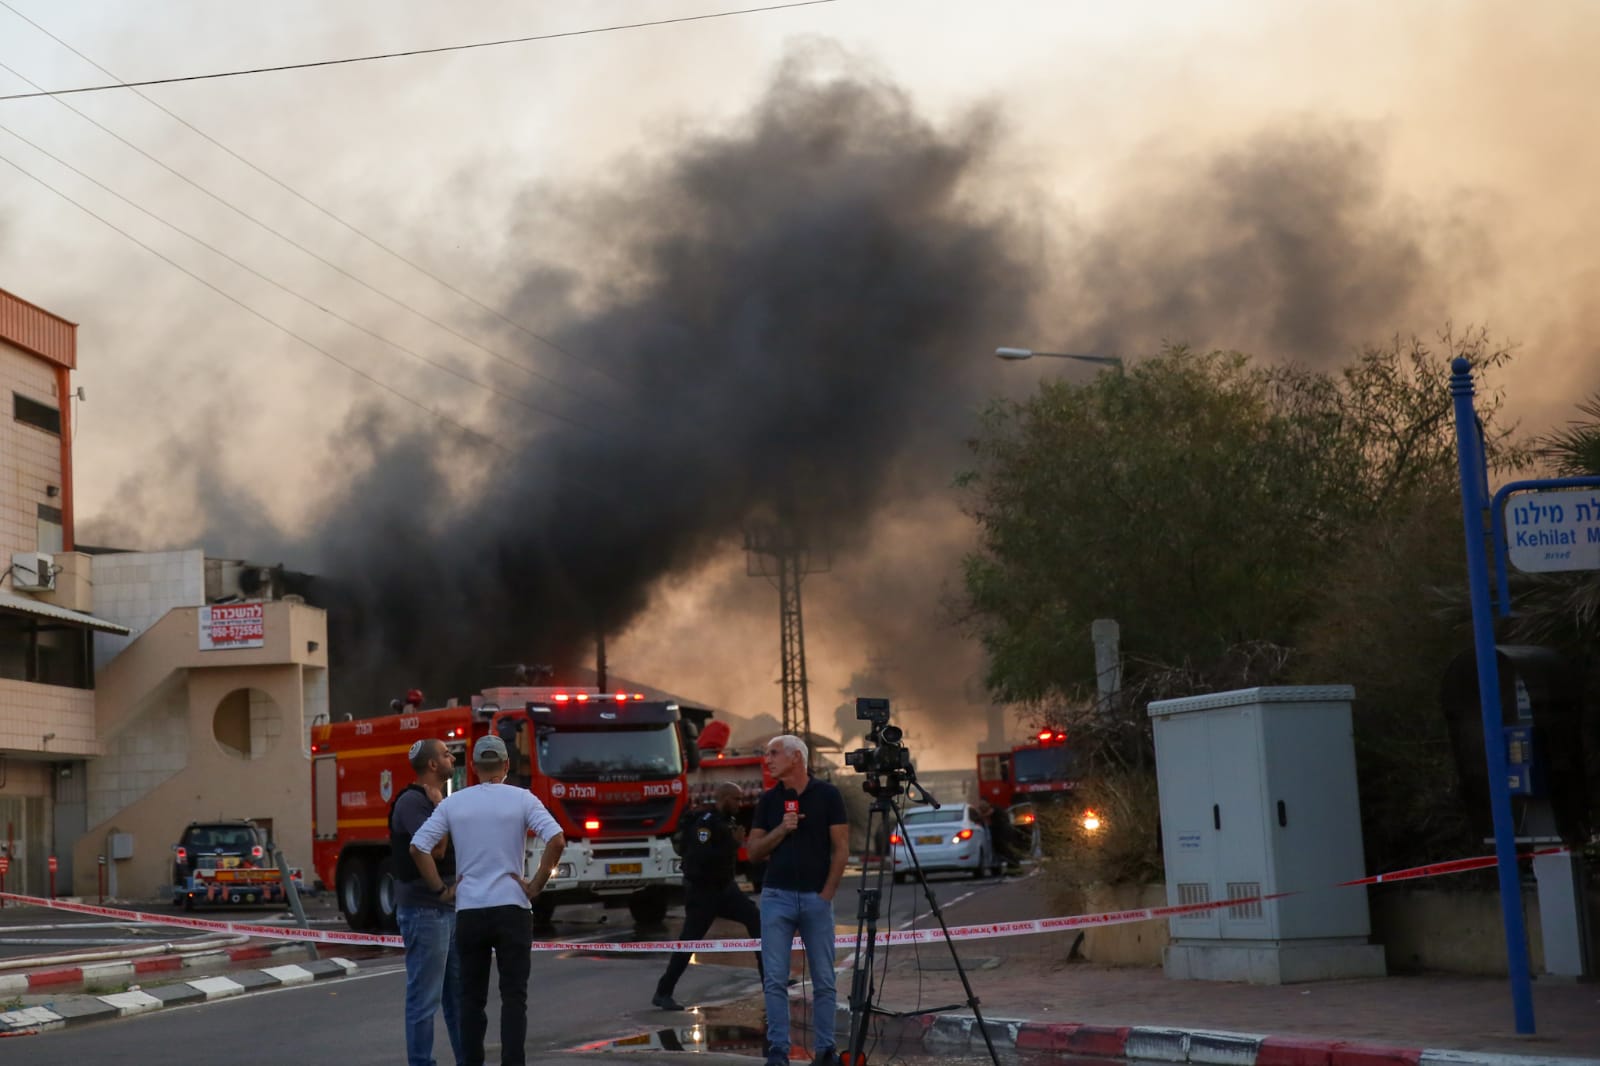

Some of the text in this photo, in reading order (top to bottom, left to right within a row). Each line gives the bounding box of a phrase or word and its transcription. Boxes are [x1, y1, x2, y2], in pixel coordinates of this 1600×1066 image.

[1514, 500, 1564, 525] מילנו
[1516, 529, 1576, 547] Kehilat
[212, 605, 262, 619] להשכרה
[569, 784, 596, 798] והצלה
[643, 784, 670, 796] כבאות
